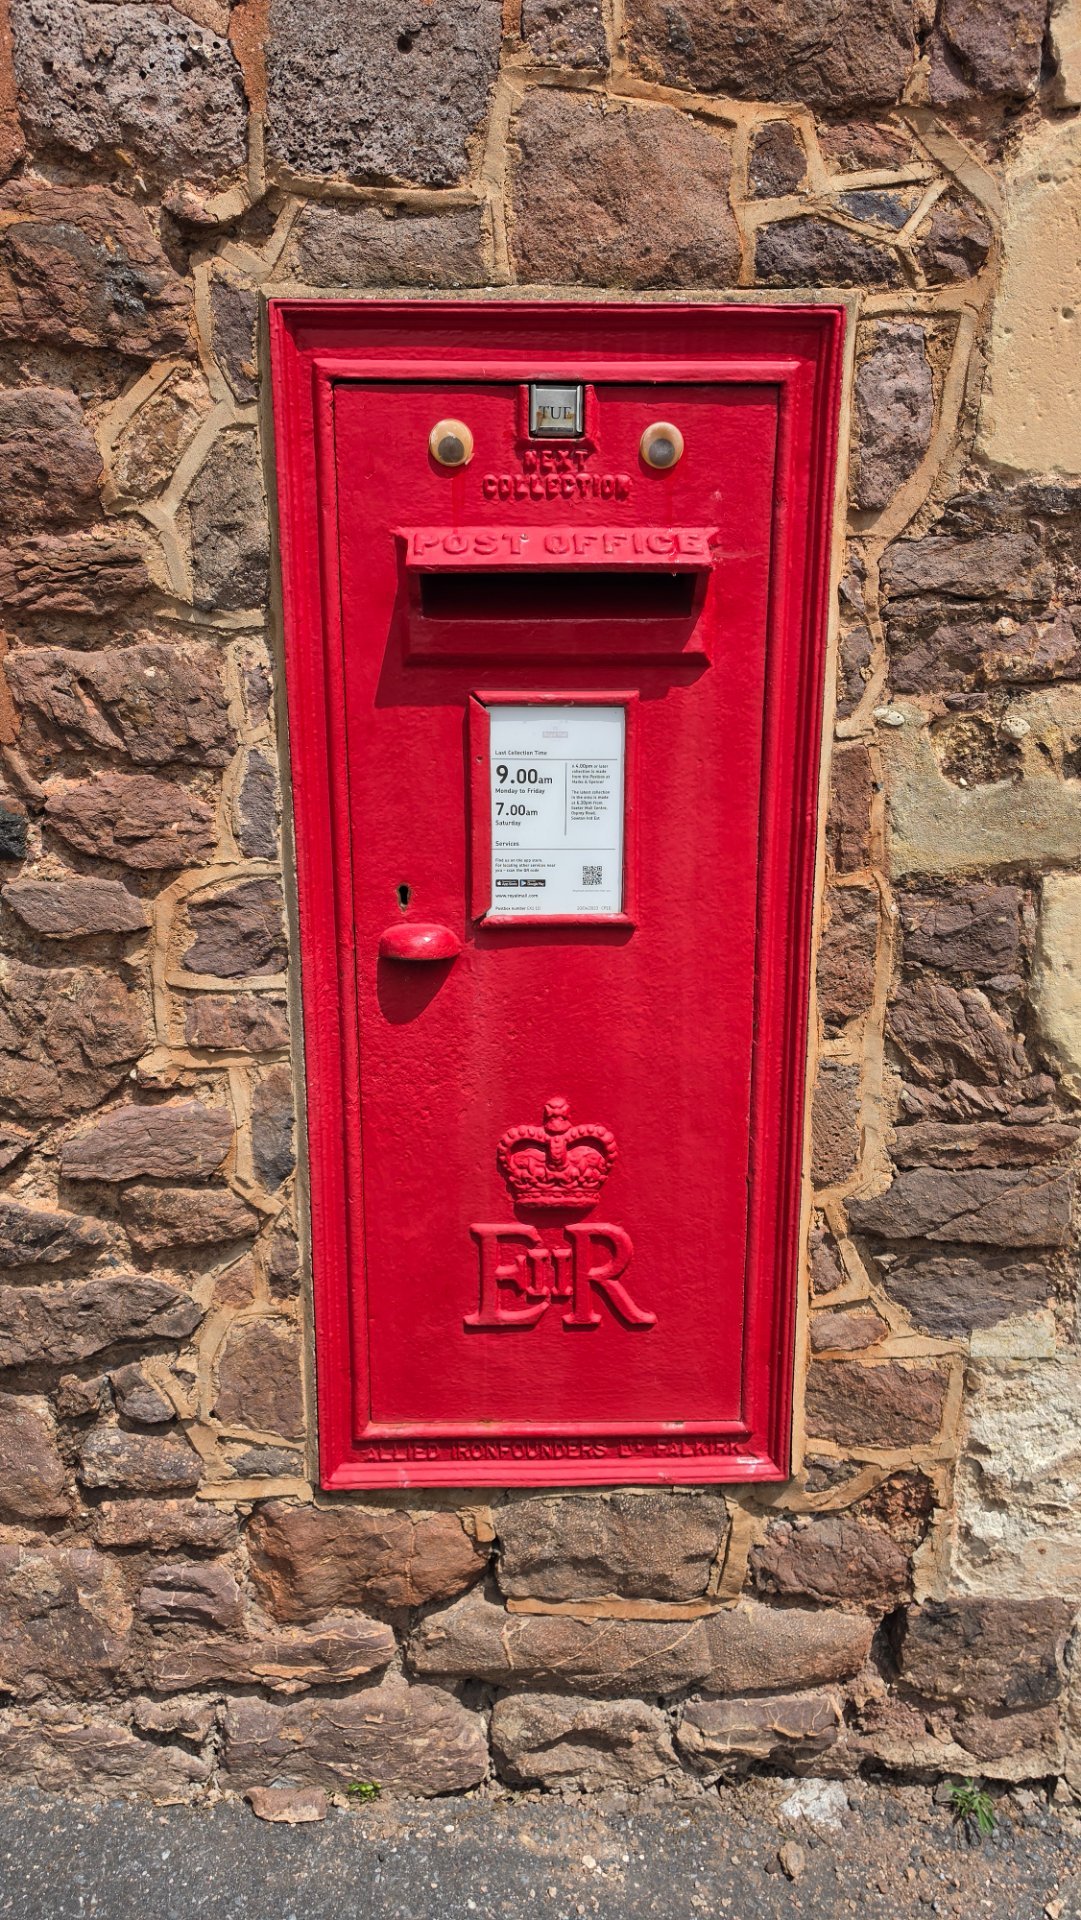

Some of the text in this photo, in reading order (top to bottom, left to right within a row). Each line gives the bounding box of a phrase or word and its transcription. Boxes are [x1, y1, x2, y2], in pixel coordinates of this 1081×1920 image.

[523, 450, 589, 472] NEXT
[482, 473, 633, 500] COLLECTION
[412, 533, 702, 556] POST OFFICE
[496, 764, 553, 784] 9.00am
[496, 802, 538, 816] 7.00am
[366, 1443, 440, 1463] ALLIED
[450, 1440, 606, 1462] IRONFOUNDERS
[653, 1439, 742, 1459] FALKIRK
